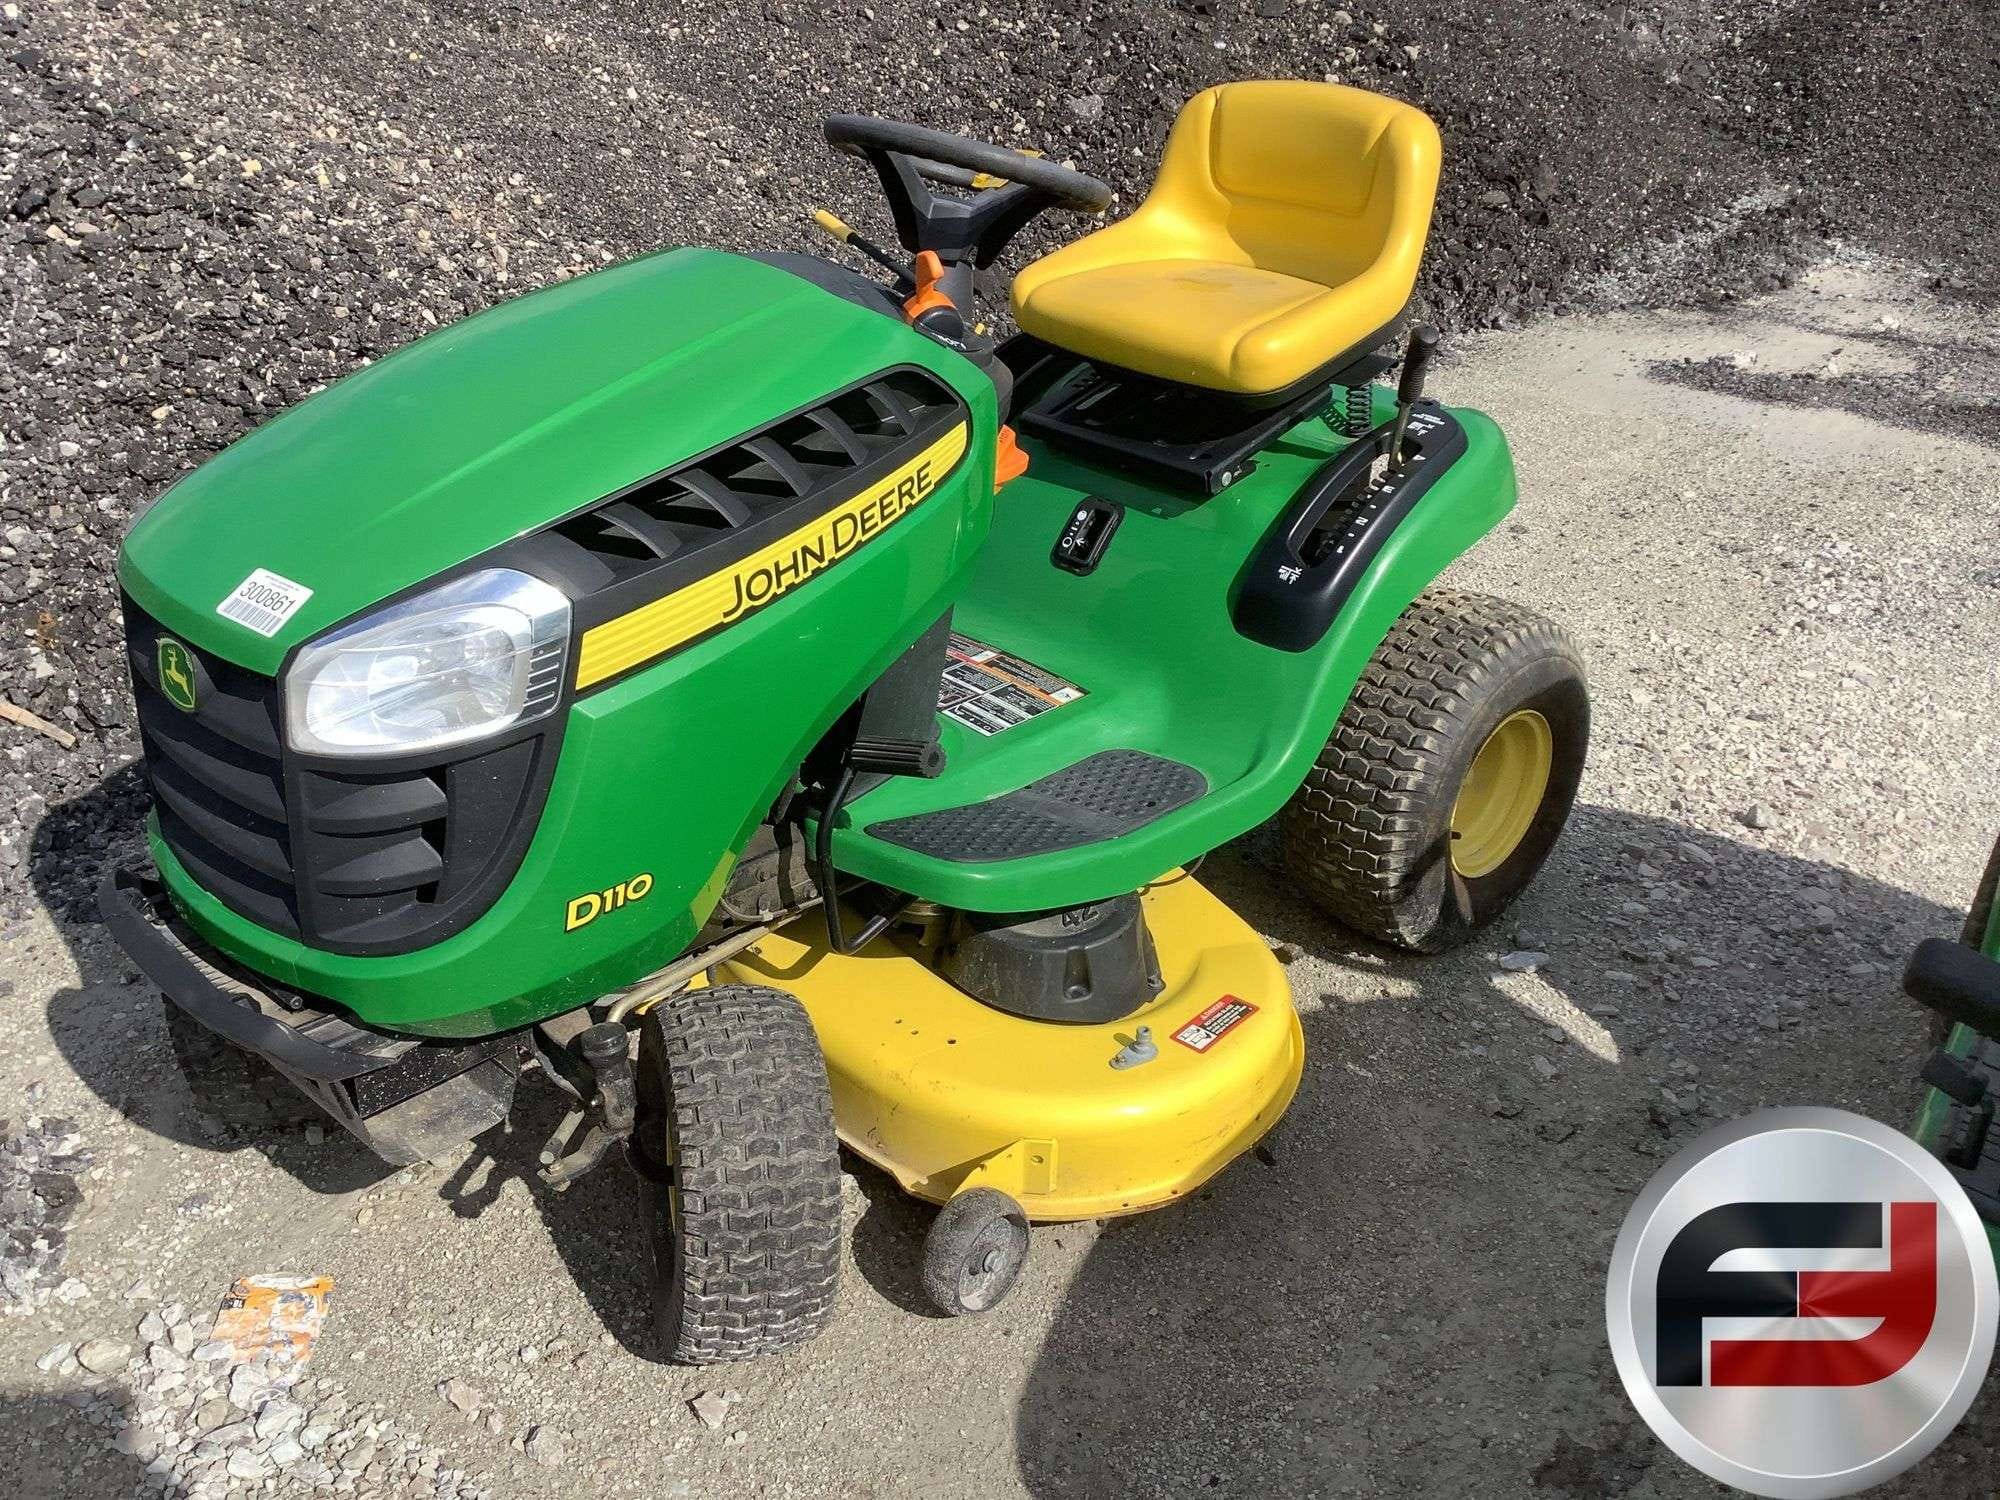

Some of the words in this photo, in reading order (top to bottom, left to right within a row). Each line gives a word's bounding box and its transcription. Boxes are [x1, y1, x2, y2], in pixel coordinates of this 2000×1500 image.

[722, 534, 825, 619] JOHN
[831, 460, 933, 553] DEERE
[239, 581, 296, 615] 300861
[564, 872, 655, 934] D110
